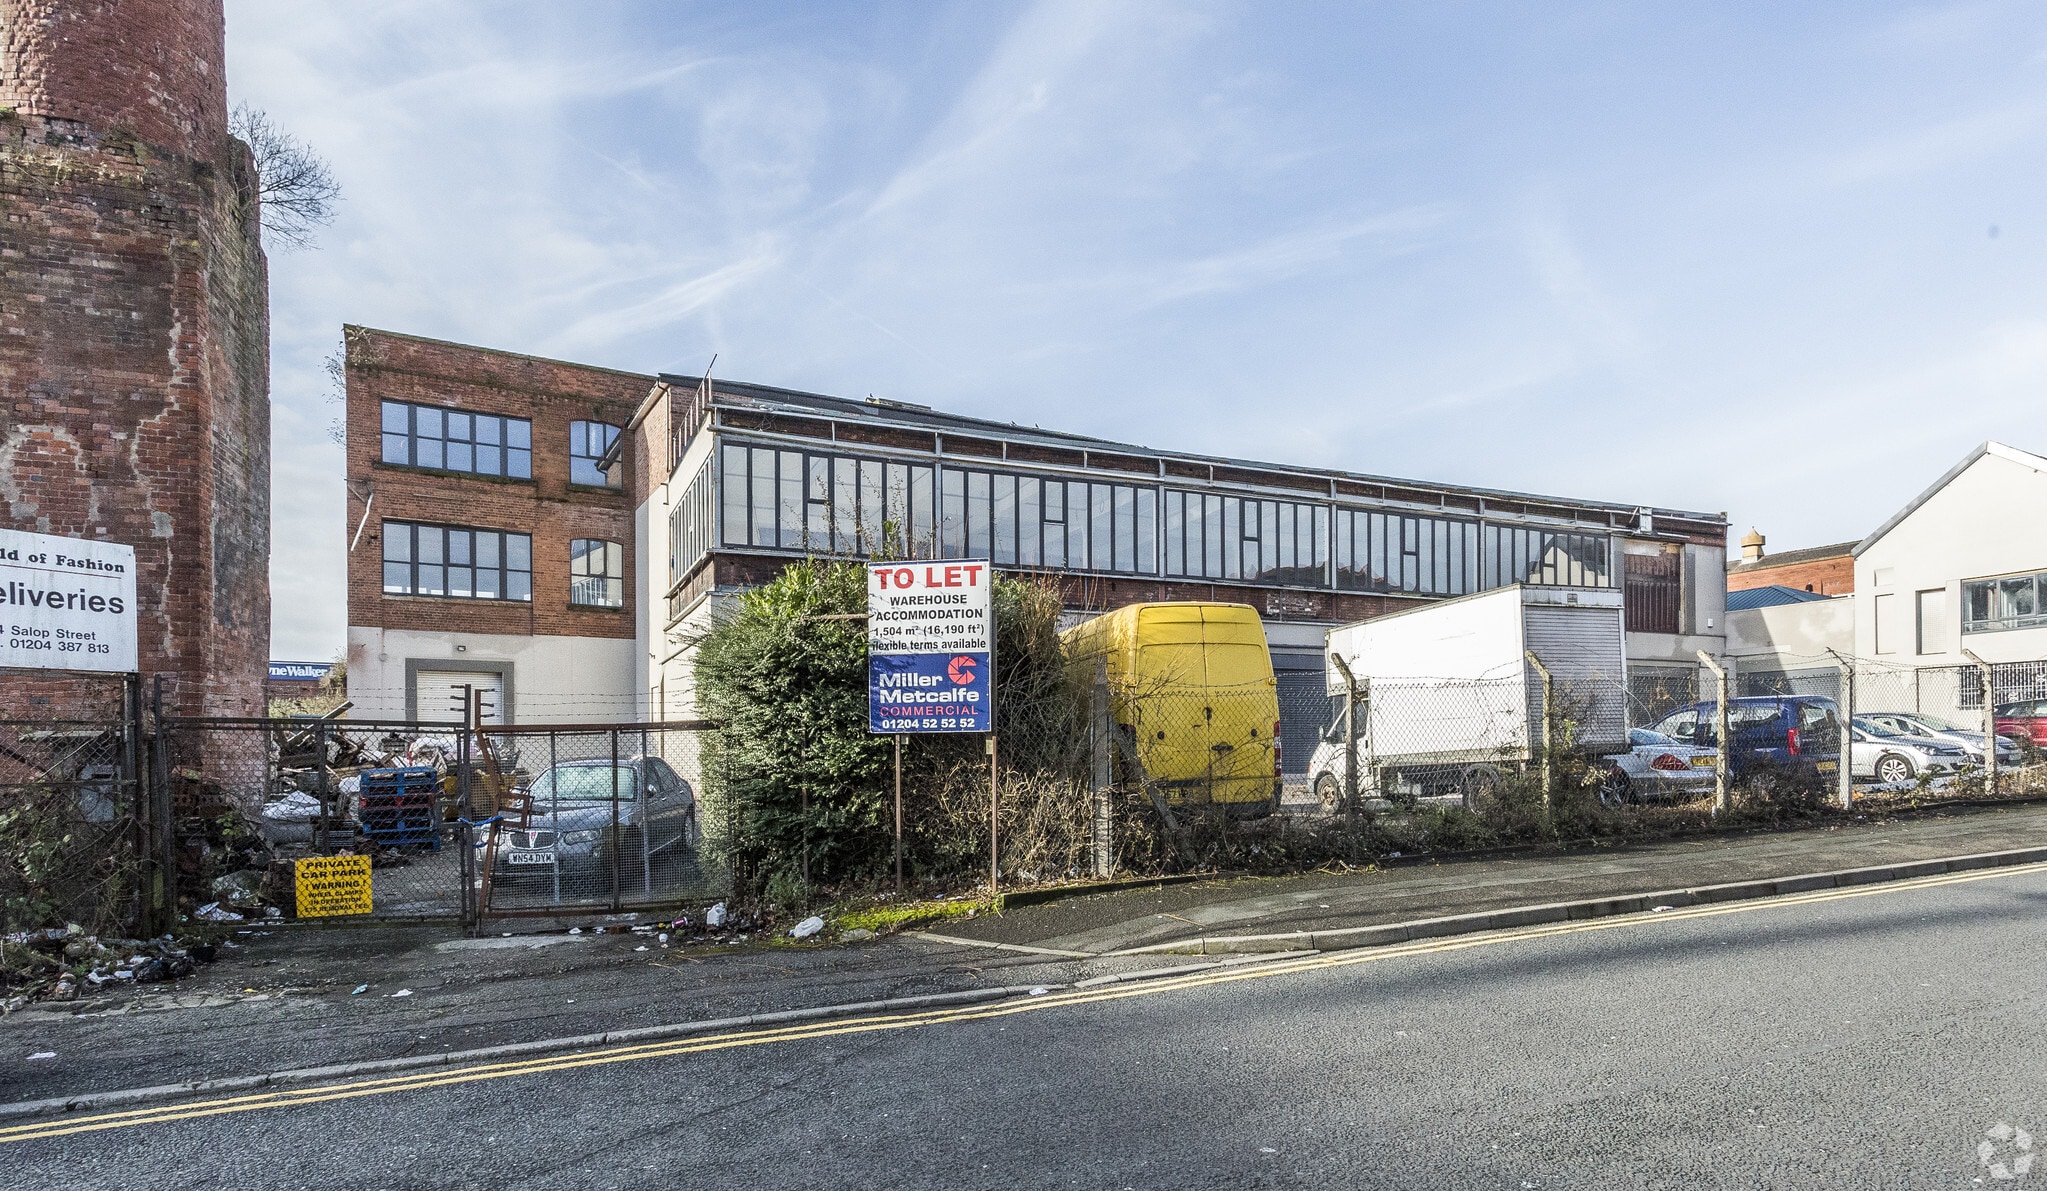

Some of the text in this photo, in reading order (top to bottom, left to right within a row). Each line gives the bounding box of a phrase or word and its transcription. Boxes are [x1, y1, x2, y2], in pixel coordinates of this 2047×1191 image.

[28, 553, 47, 564] of
[56, 554, 125, 573] Fashion
[874, 565, 983, 590] TO LET
[890, 594, 968, 607] WAREHOUSE
[876, 608, 983, 621] ACCOMMODATION
[11, 625, 50, 639] Salop
[56, 628, 97, 641] Street
[874, 626, 902, 638] 1,504
[923, 625, 964, 636] (16,190
[10, 638, 110, 654] 01204 387 813
[910, 640, 938, 650] terms
[941, 638, 987, 649] available
[879, 672, 943, 687] Miller
[879, 688, 980, 703] Metcalfe
[880, 705, 979, 716] COMMERCIAL
[882, 718, 975, 729] 01204 52 52 52
[306, 859, 361, 869] PRIVATE
[301, 869, 366, 879] CAR PARK
[311, 880, 360, 890] WARNING
